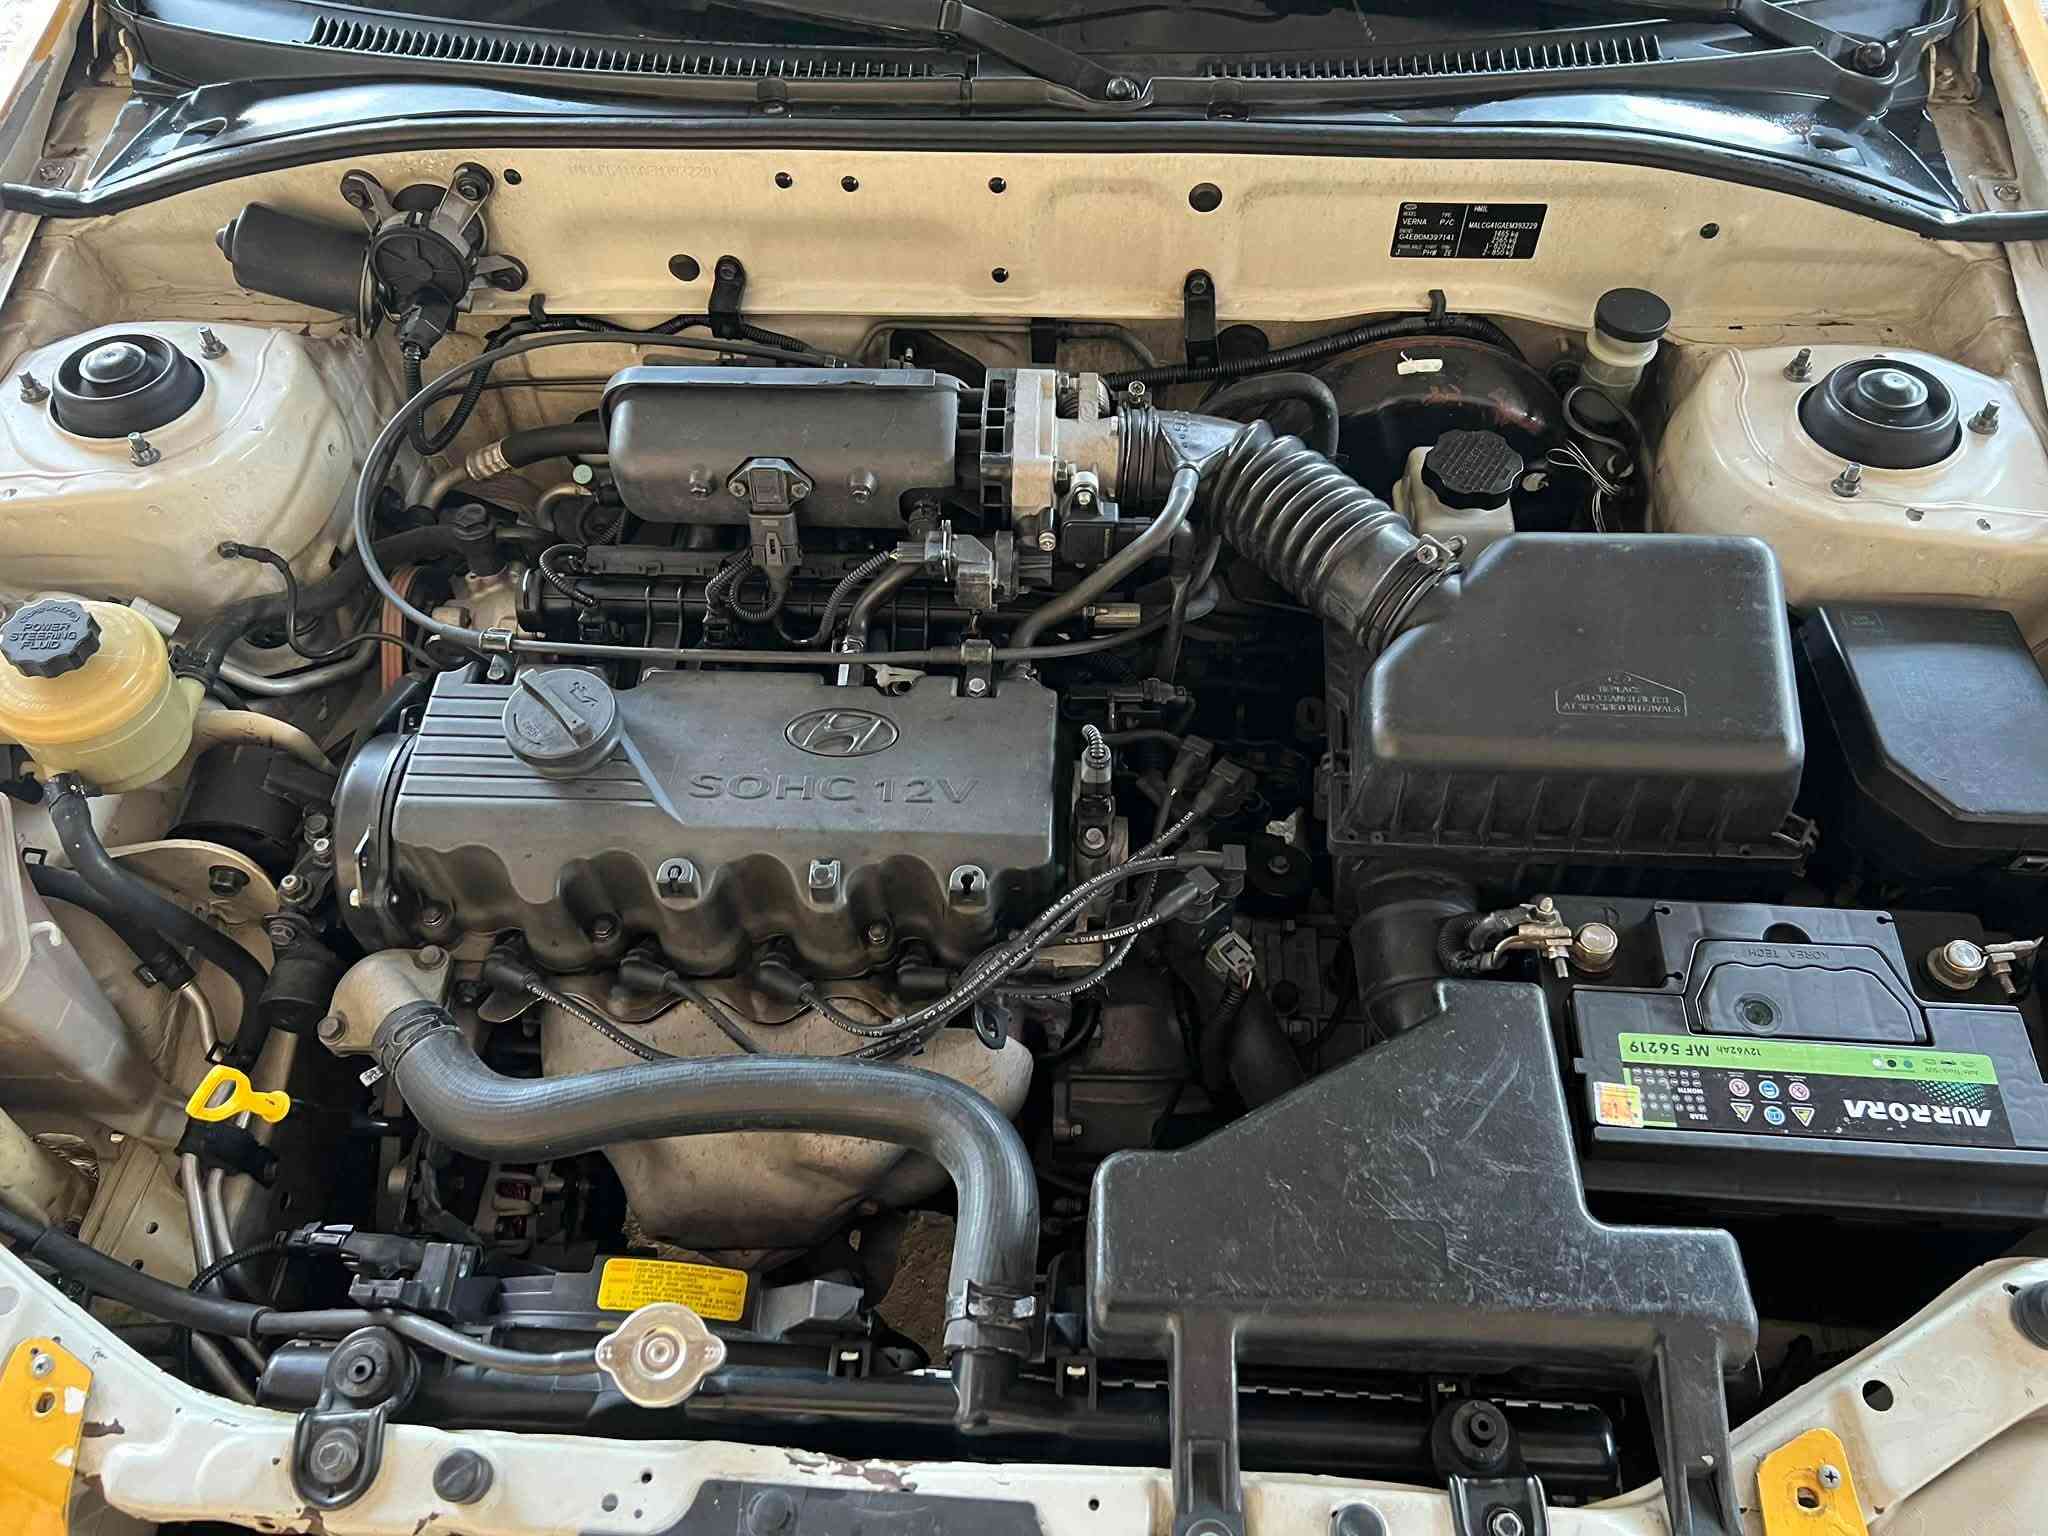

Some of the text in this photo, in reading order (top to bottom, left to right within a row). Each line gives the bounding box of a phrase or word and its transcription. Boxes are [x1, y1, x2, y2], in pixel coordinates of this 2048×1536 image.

[1439, 218, 1455, 226] P/C
[23, 623, 71, 631] POWER
[9, 631, 78, 641] STEERING
[20, 641, 61, 650] FLUID
[688, 773, 979, 804] SOHC 12V
[1102, 926, 1135, 940] MAKING
[1136, 917, 1155, 931] FOR
[1748, 949, 1830, 960] TECH KOREA
[957, 973, 985, 997] MAKING
[1630, 1041, 1762, 1057] 56219 MF 12V62Ah
[1689, 1113, 1709, 1121] YEAR
[1843, 1099, 1993, 1128] AURRORA
